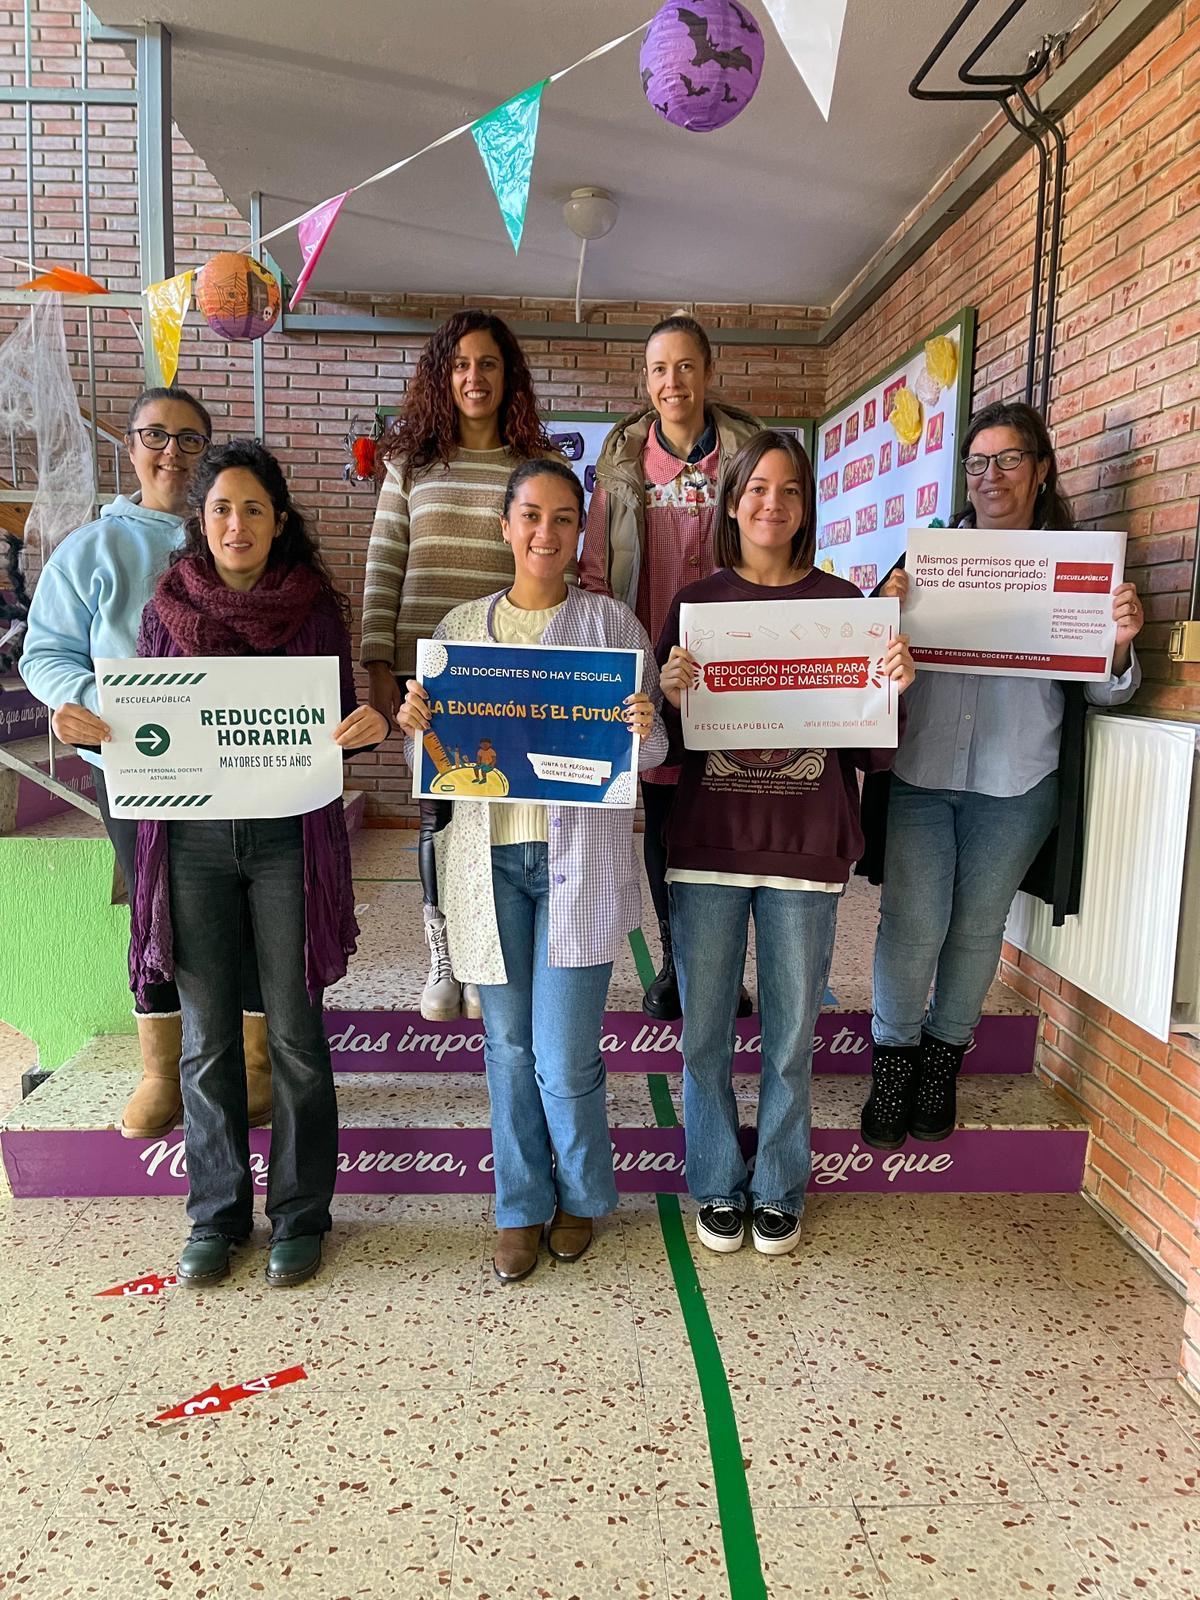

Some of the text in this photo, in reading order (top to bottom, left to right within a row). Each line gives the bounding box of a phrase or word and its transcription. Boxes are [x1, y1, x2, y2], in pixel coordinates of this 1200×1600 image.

[928, 416, 942, 450] LA
[917, 555, 1049, 569] Mismos permisos que el
[916, 566, 1046, 579] resto del funcionariado:
[942, 578, 956, 588] de
[959, 580, 1001, 589] asuntos
[1004, 582, 1047, 592] propios
[912, 648, 932, 656] JUNTA
[982, 652, 1013, 660] DOCENTE
[450, 666, 622, 682] SIN DOCENTES NO HAY ESCUELA
[707, 662, 867, 675] REDUCCIÓN HORARIA PARA
[714, 674, 860, 687] EL CUERPO DE MAESTROS
[115, 694, 191, 704] #ESCUELAPÚBLICA
[200, 705, 326, 726] REDUCCIÓN
[448, 700, 527, 718] EDUCACIÓN
[531, 704, 547, 720] ES
[551, 705, 568, 720] EL
[217, 729, 312, 746] HORARIA
[219, 753, 312, 768] MAYORES DE 55 AÑOS
[542, 769, 593, 780] DOCENTE ASTURIAS
[569, 764, 595, 772] PERSONAL
[328, 1024, 391, 1053] das
[397, 1025, 485, 1062] impo
[599, 1033, 627, 1053] a
[829, 1026, 869, 1055] tu
[337, 1150, 467, 1177] arrera,
[882, 1152, 954, 1182] que
[123, 1283, 154, 1297] 5
[242, 1375, 277, 1393] 4
[184, 1396, 220, 1415] 3
